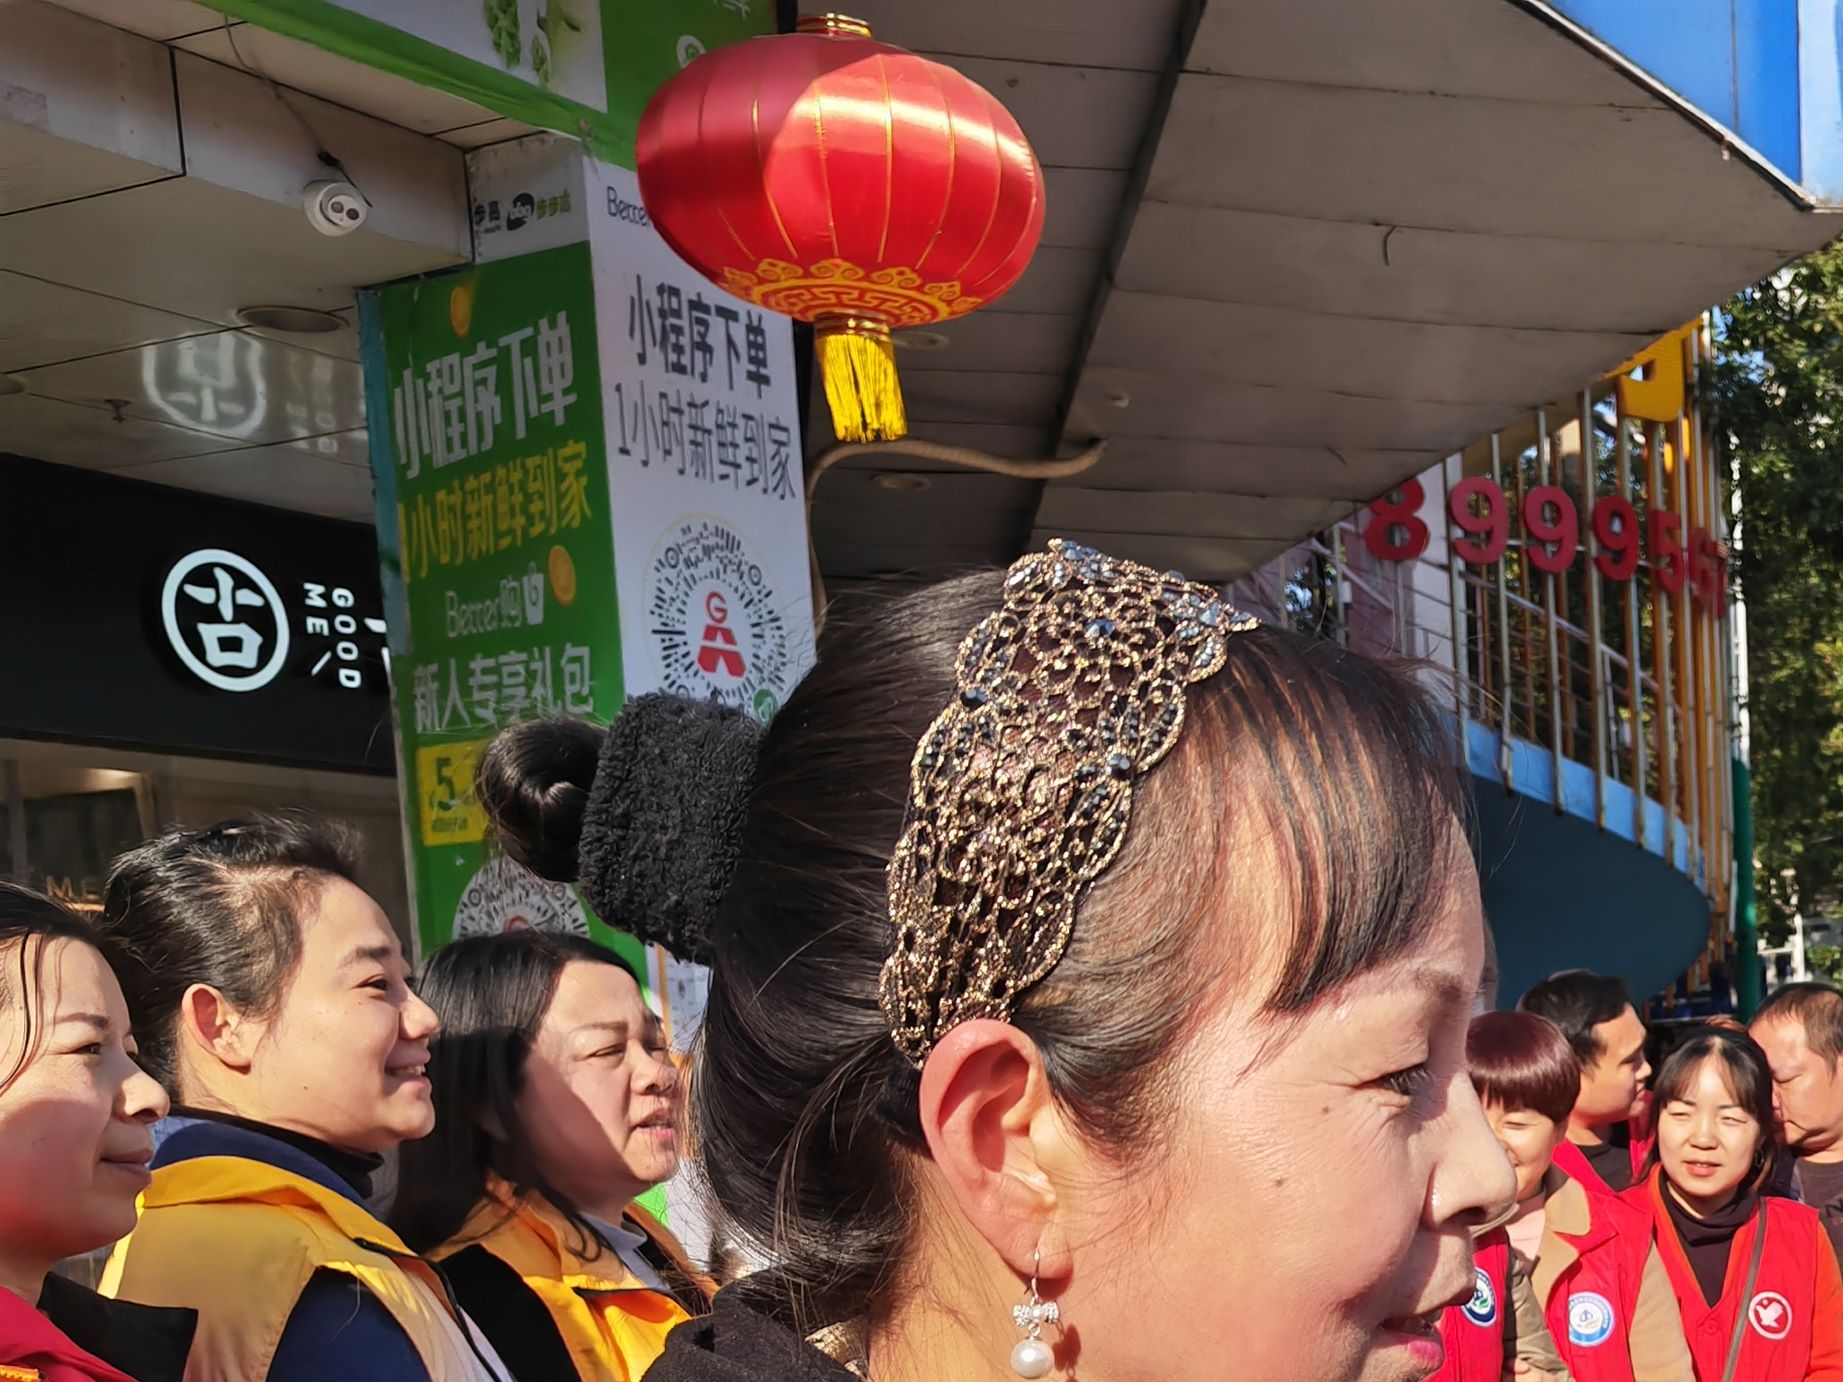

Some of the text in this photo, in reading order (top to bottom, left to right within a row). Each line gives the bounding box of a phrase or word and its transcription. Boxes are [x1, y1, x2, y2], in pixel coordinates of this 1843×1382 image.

[393, 309, 578, 480] 小程序下单
[628, 273, 771, 399] 小程序下单
[614, 380, 796, 501] 1小时新鲜到家
[332, 587, 361, 688] GOOD
[412, 642, 596, 734] 新人专享礼包
